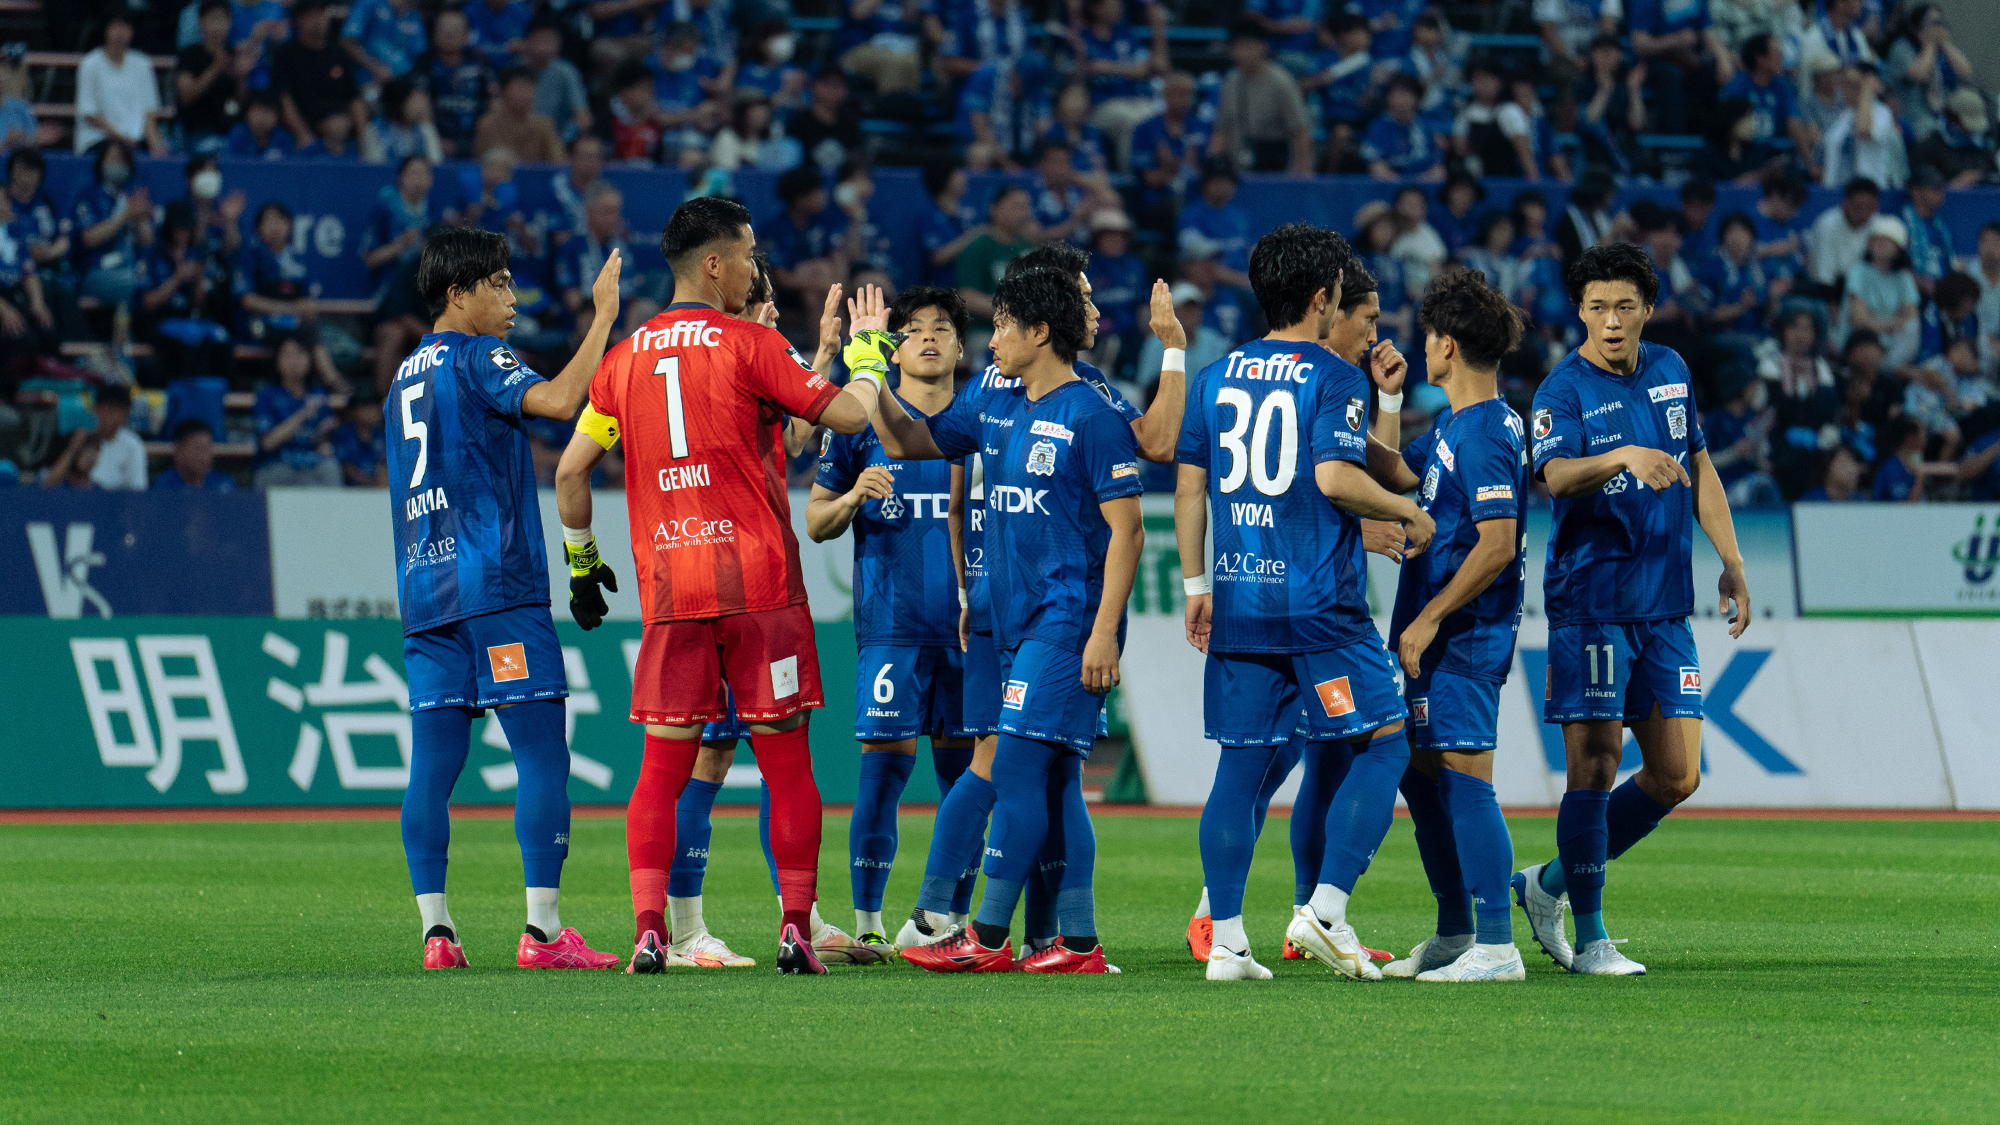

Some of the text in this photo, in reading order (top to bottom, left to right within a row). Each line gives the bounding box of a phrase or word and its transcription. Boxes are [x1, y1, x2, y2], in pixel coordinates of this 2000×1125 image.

[631, 320, 722, 353] Traffic
[396, 339, 449, 381] raffic
[1225, 351, 1314, 384] Traffic
[651, 355, 689, 460] 1
[401, 381, 427, 491] 5
[1216, 387, 1300, 496] 30
[1591, 434, 1622, 446] ATHLETA
[658, 464, 711, 491] GENKI
[903, 493, 950, 519] TD
[995, 485, 1051, 515] TDK
[1478, 491, 1512, 501] COROLLA
[654, 516, 733, 543] A2Care
[683, 538, 702, 547] with
[703, 535, 735, 545] Science
[430, 552, 457, 566] Science
[1214, 552, 1286, 576] A2Care
[1239, 574, 1256, 583] with
[1257, 575, 1285, 584] Science
[1585, 644, 1614, 685] 11
[873, 663, 895, 704] 6
[1683, 674, 1700, 687] AD
[1006, 688, 1023, 703] DK
[1584, 690, 1616, 698] ATHLETA
[866, 710, 899, 718] ATHLETA
[1414, 704, 1427, 720] DK
[1045, 955, 1092, 971] PENALTY
